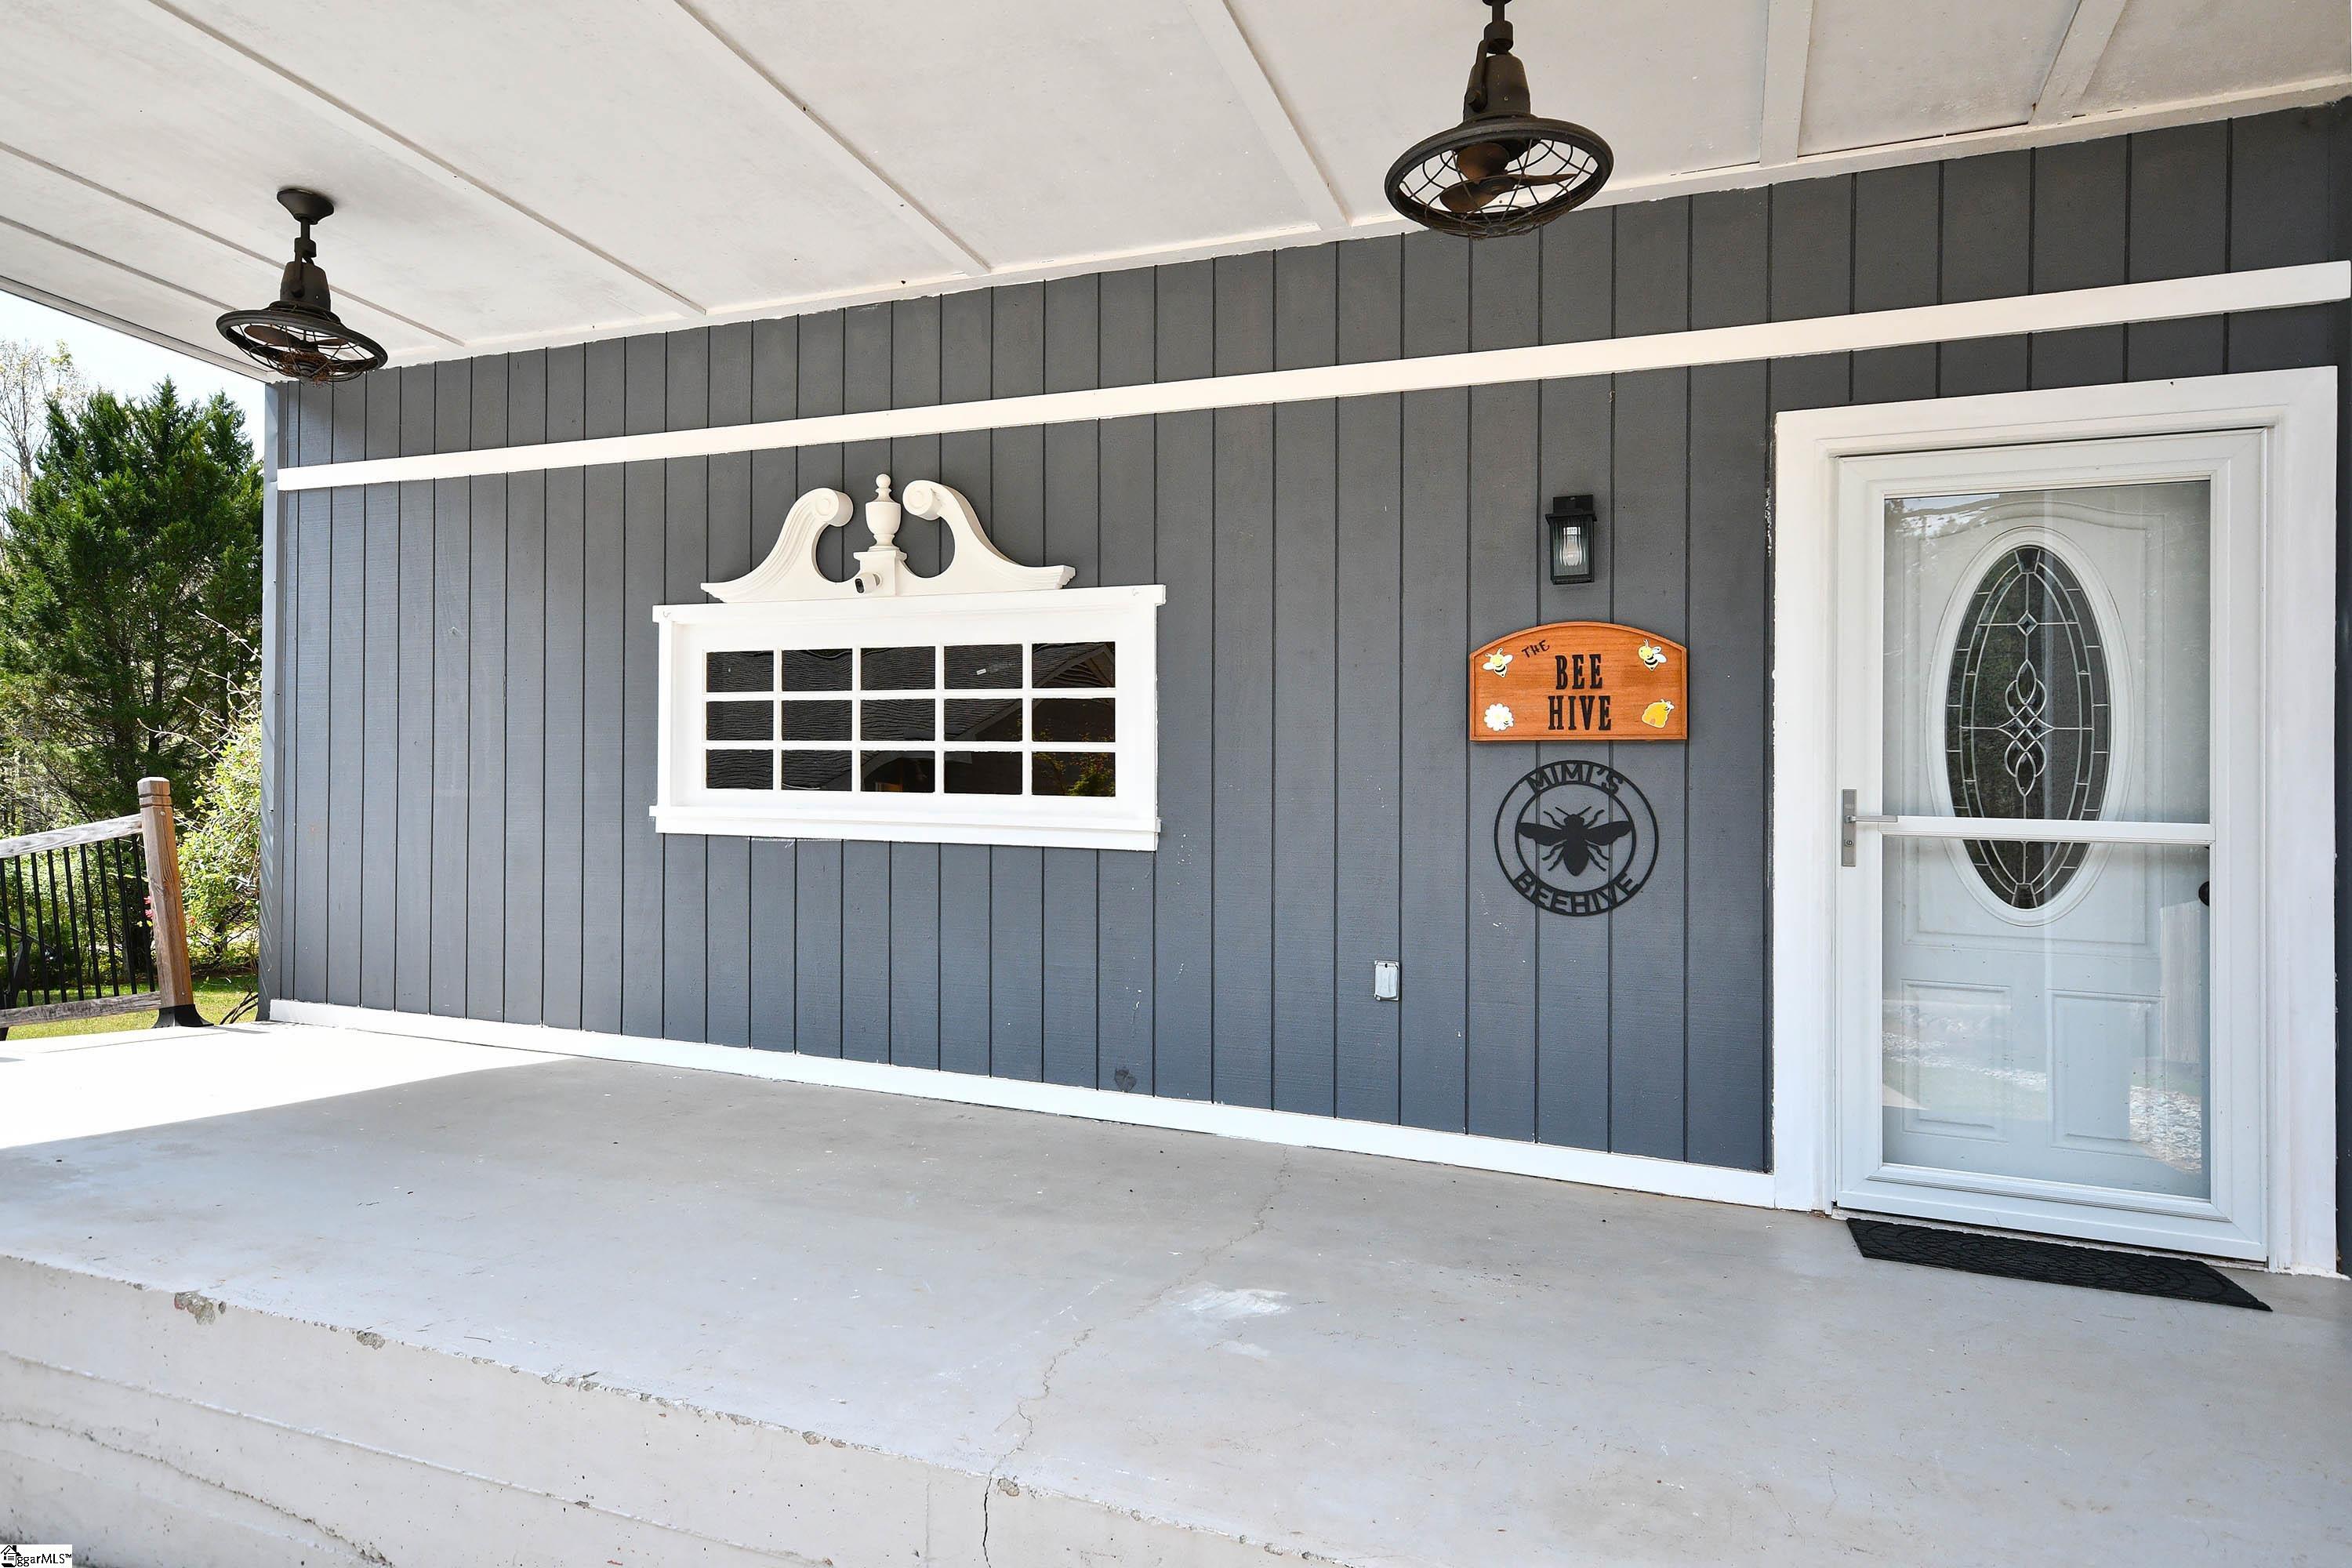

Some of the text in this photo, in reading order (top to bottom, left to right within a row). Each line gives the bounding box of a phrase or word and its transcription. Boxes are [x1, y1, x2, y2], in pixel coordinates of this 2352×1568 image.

[1522, 640, 1550, 658] THE
[1555, 654, 1603, 690] BEE
[1548, 695, 1612, 731] HIVE
[1526, 763, 1624, 797] MIMI'S
[1512, 869, 1641, 916] BEEHIVE
